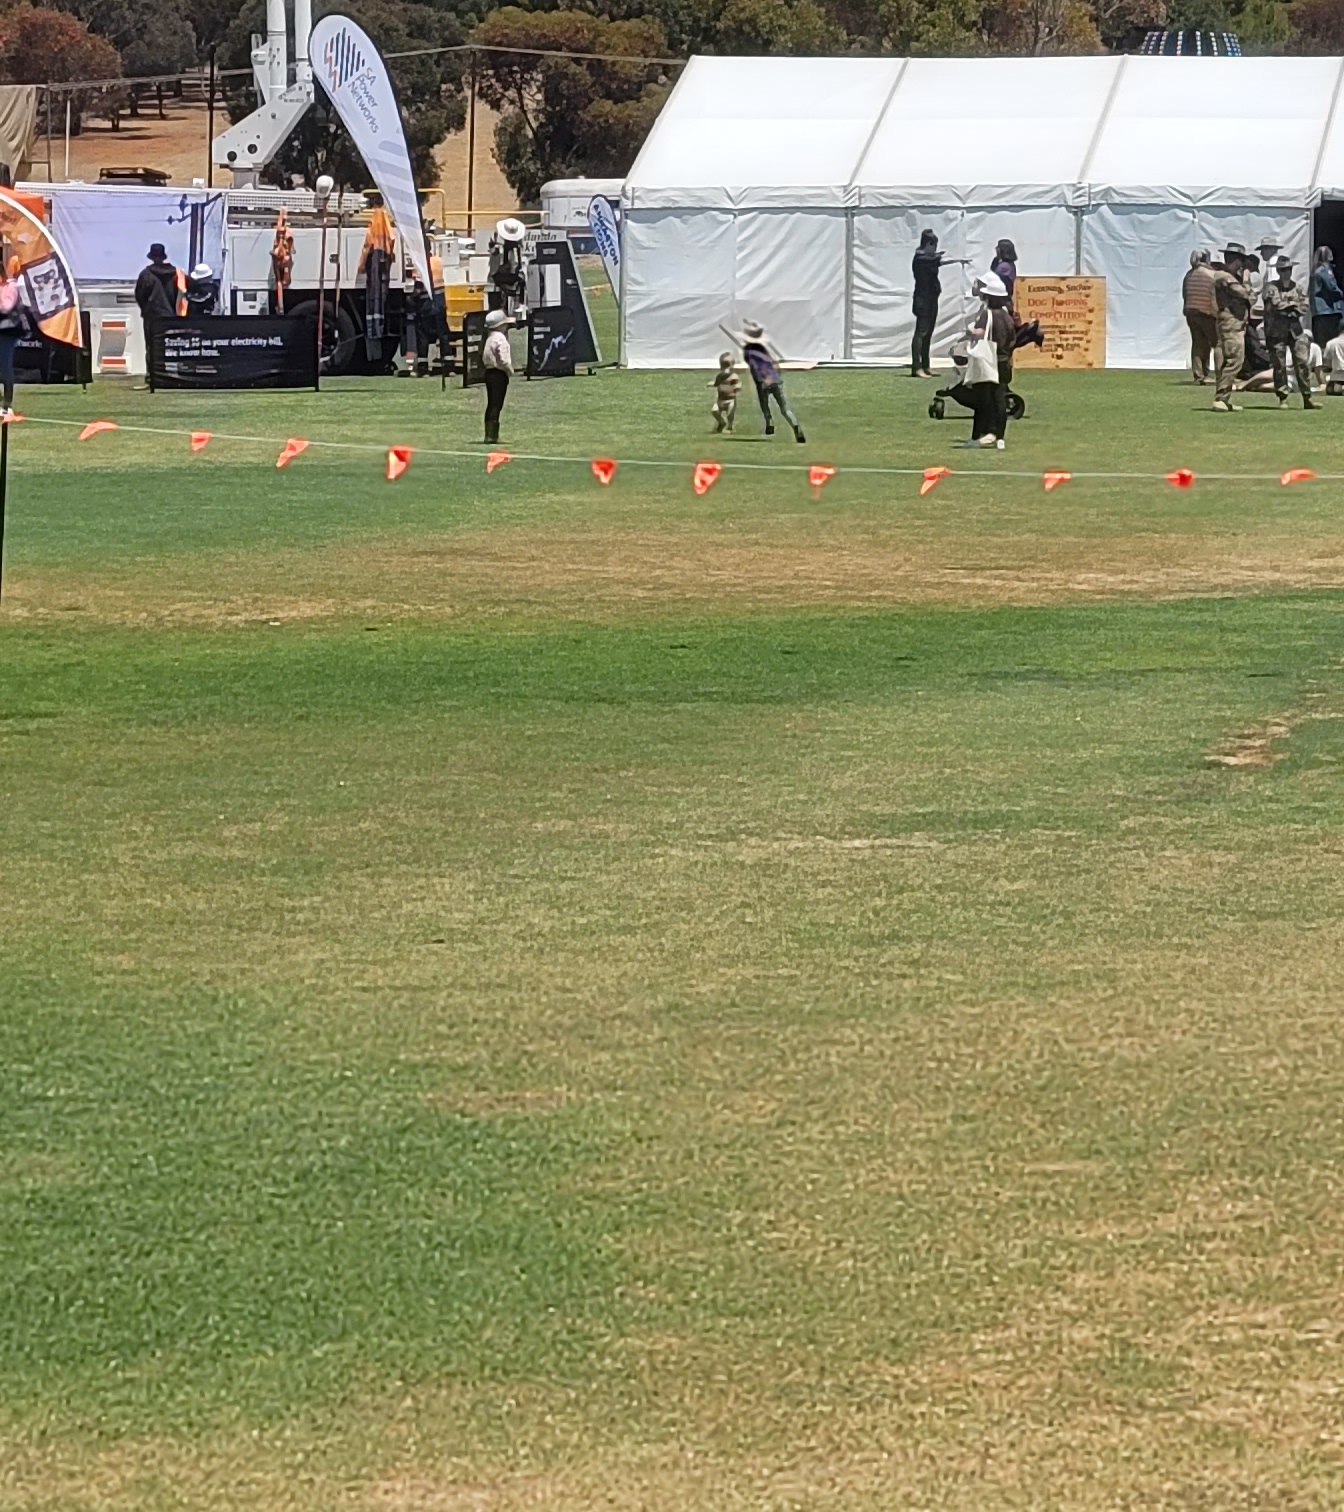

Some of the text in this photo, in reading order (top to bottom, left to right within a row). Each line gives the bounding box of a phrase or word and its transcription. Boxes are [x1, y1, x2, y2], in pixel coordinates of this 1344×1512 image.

[366, 67, 376, 86] SA
[347, 81, 379, 134] Networks
[212, 339, 229, 348] your
[231, 337, 267, 348] electricity
[268, 336, 284, 346] bill.
[179, 348, 200, 357] know
[201, 348, 220, 357] how.
